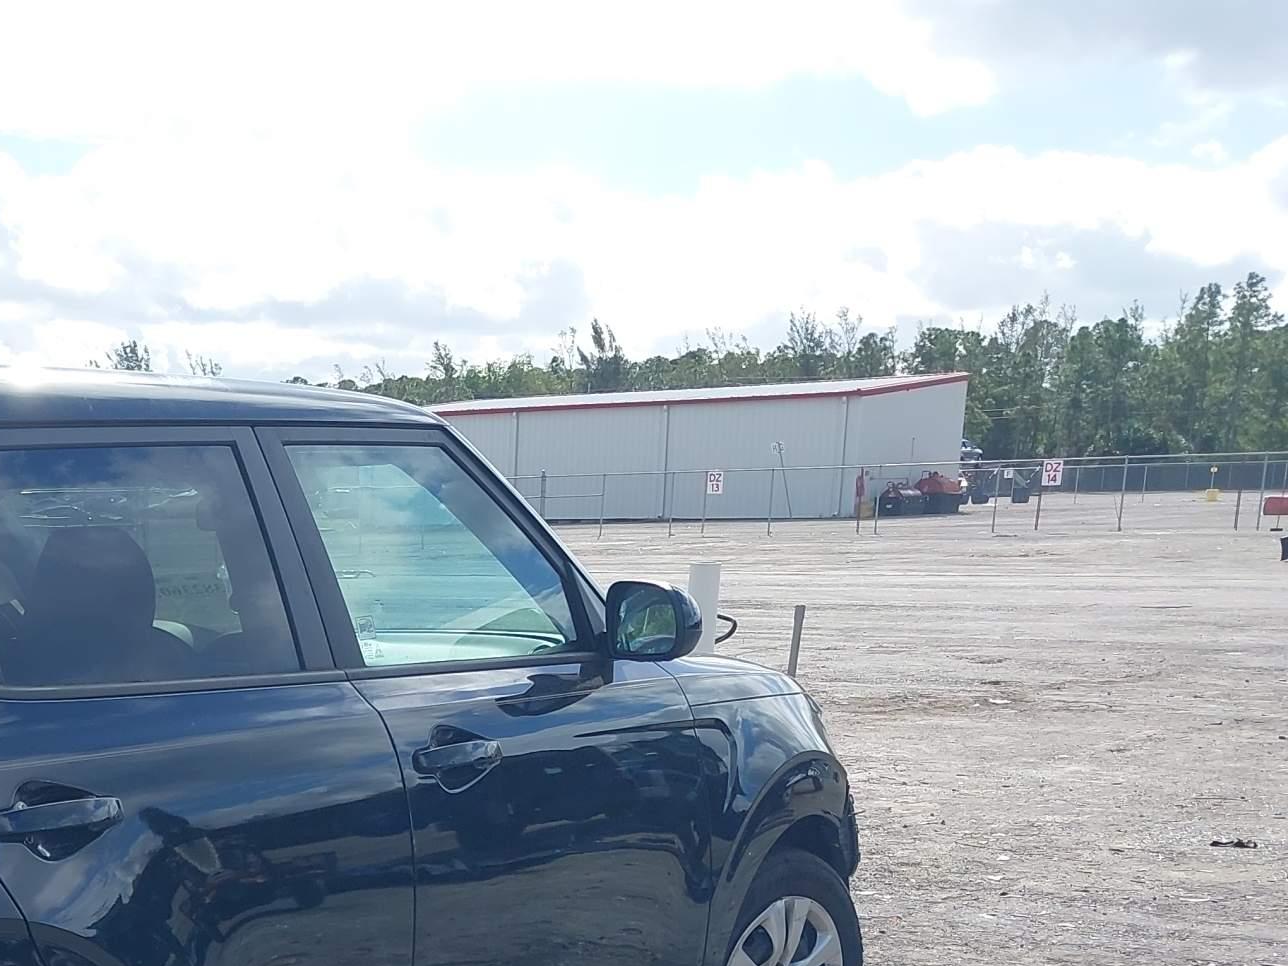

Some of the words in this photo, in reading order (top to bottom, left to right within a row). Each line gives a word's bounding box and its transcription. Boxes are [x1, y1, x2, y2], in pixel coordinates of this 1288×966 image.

[1044, 462, 1062, 473] DZ
[709, 473, 722, 483] DZ
[1047, 473, 1058, 485] 14
[711, 483, 720, 492] 13
